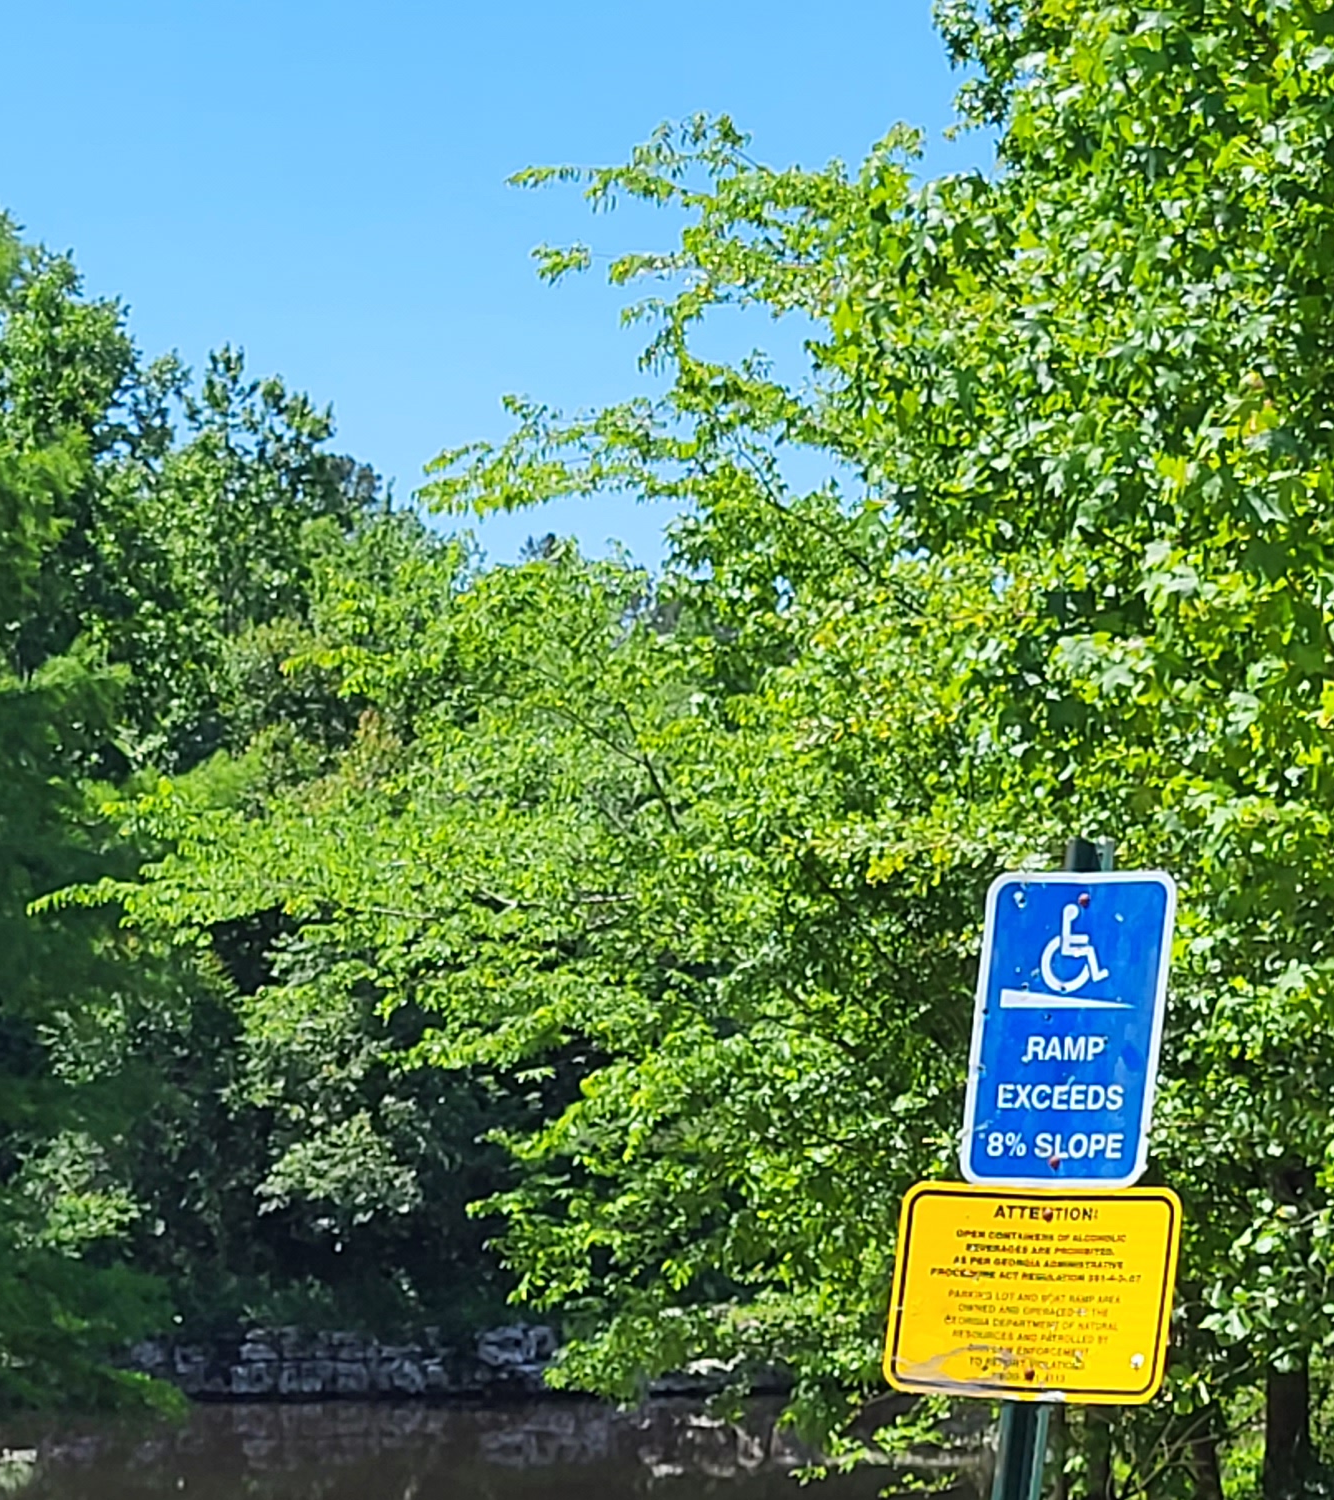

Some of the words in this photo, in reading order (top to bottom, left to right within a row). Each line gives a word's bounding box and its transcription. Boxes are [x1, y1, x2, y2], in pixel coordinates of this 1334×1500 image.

[1026, 1035, 1106, 1061] RAMP
[996, 1083, 1125, 1111] EXCEEDS
[986, 1131, 1027, 1157] 8%
[1034, 1132, 1125, 1159] SLOPE
[956, 1228, 986, 1238] OPEN
[970, 1256, 991, 1266] PER
[993, 1257, 1040, 1268] GEORGIA
